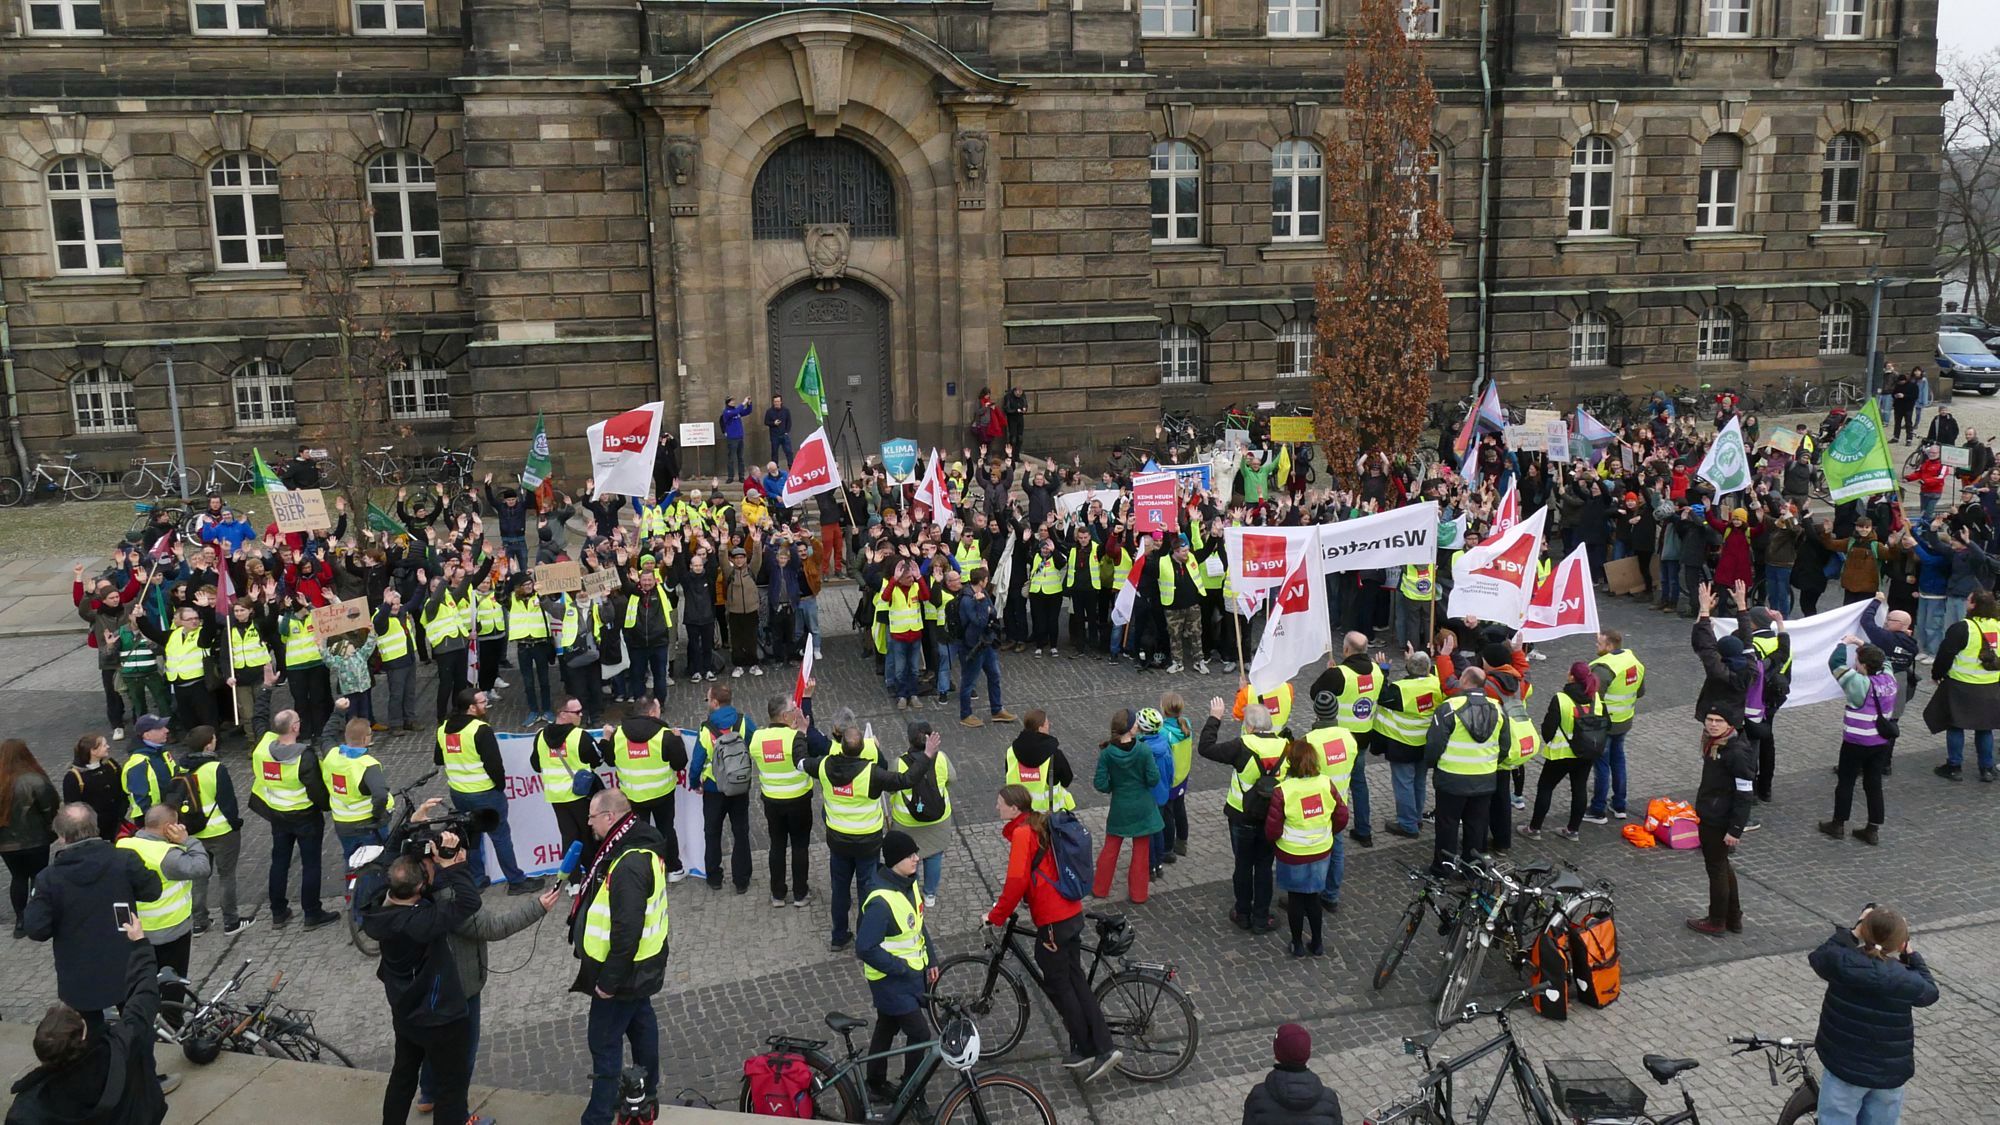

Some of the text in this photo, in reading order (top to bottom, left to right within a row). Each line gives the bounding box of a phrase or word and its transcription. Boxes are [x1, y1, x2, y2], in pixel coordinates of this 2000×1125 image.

[883, 444, 914, 454] KLIMA
[272, 492, 304, 507] KLIMA
[276, 504, 305, 521] BIER
[628, 748, 649, 756] ver.di
[763, 752, 783, 760] ver.di
[1327, 753, 1346, 761] ver.di
[1020, 771, 1040, 779] ver.di
[833, 785, 852, 795] ver.di
[1303, 806, 1323, 816] ver.di
